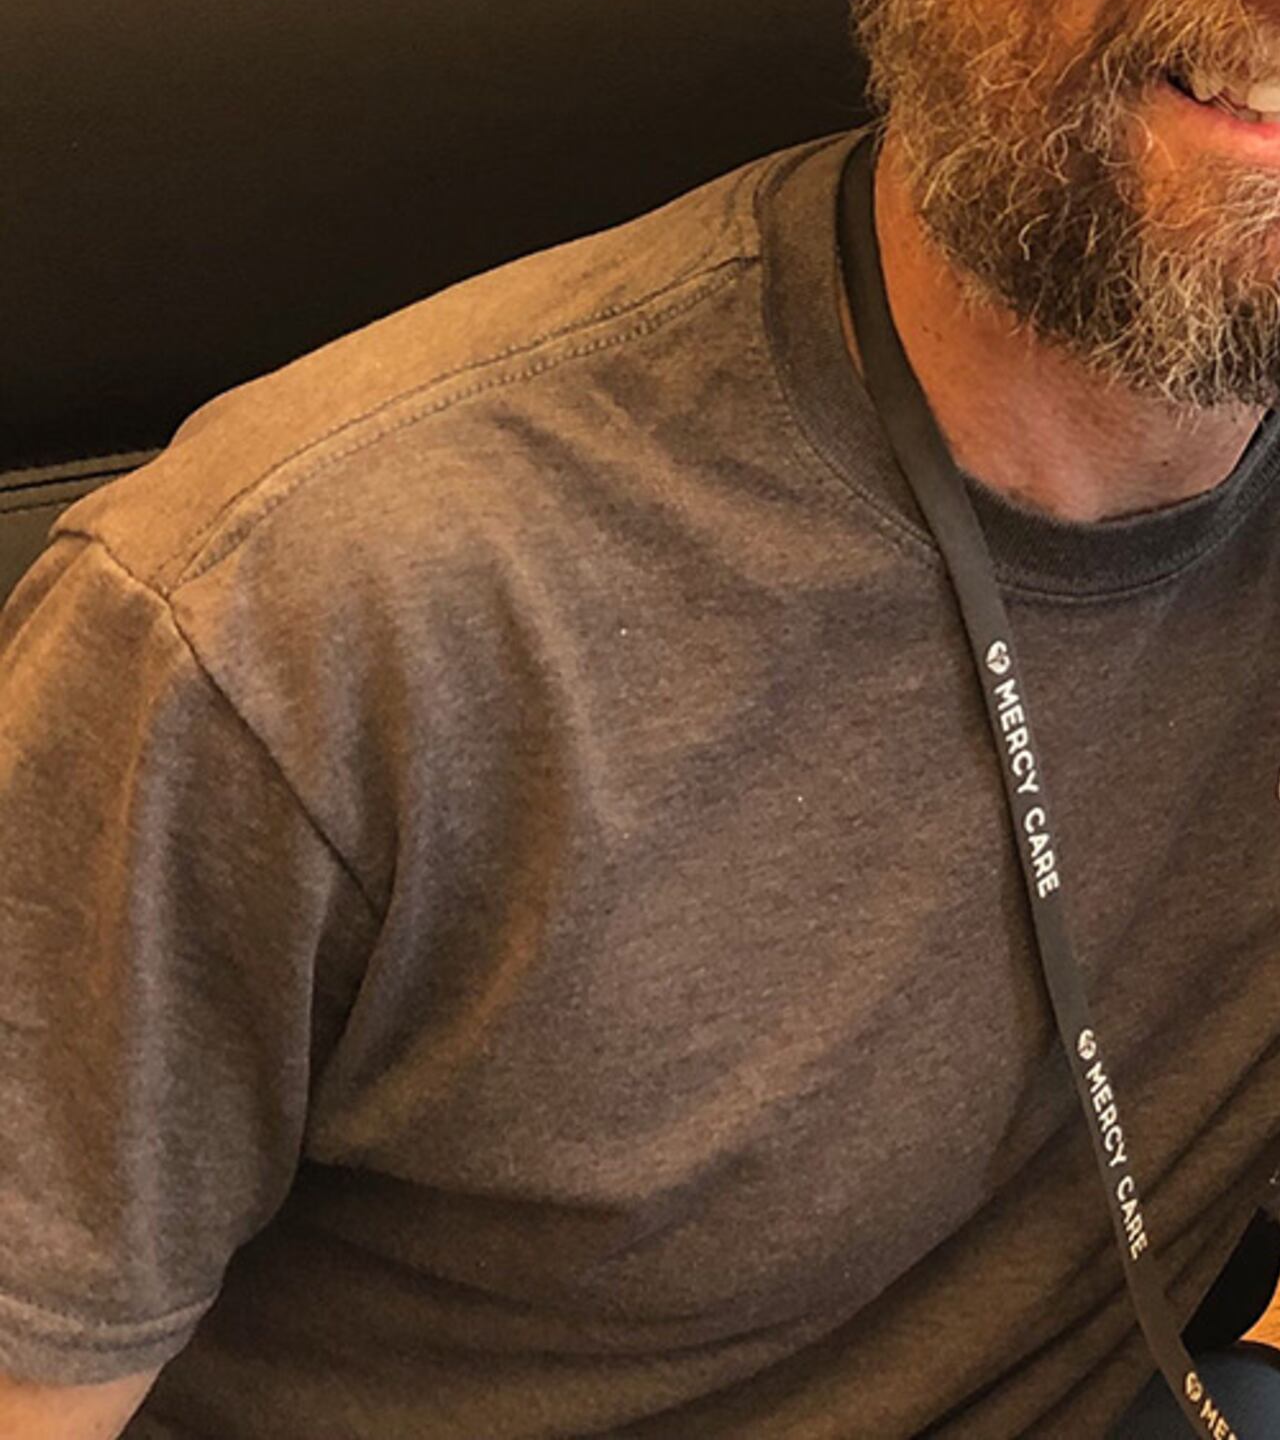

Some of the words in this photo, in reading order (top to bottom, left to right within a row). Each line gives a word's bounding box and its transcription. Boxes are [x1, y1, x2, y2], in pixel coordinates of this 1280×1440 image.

[994, 678, 1040, 794] MERCY
[1024, 807, 1060, 898] CARE
[1085, 1062, 1127, 1168] MERCY
[1116, 1176, 1148, 1260] CARE
